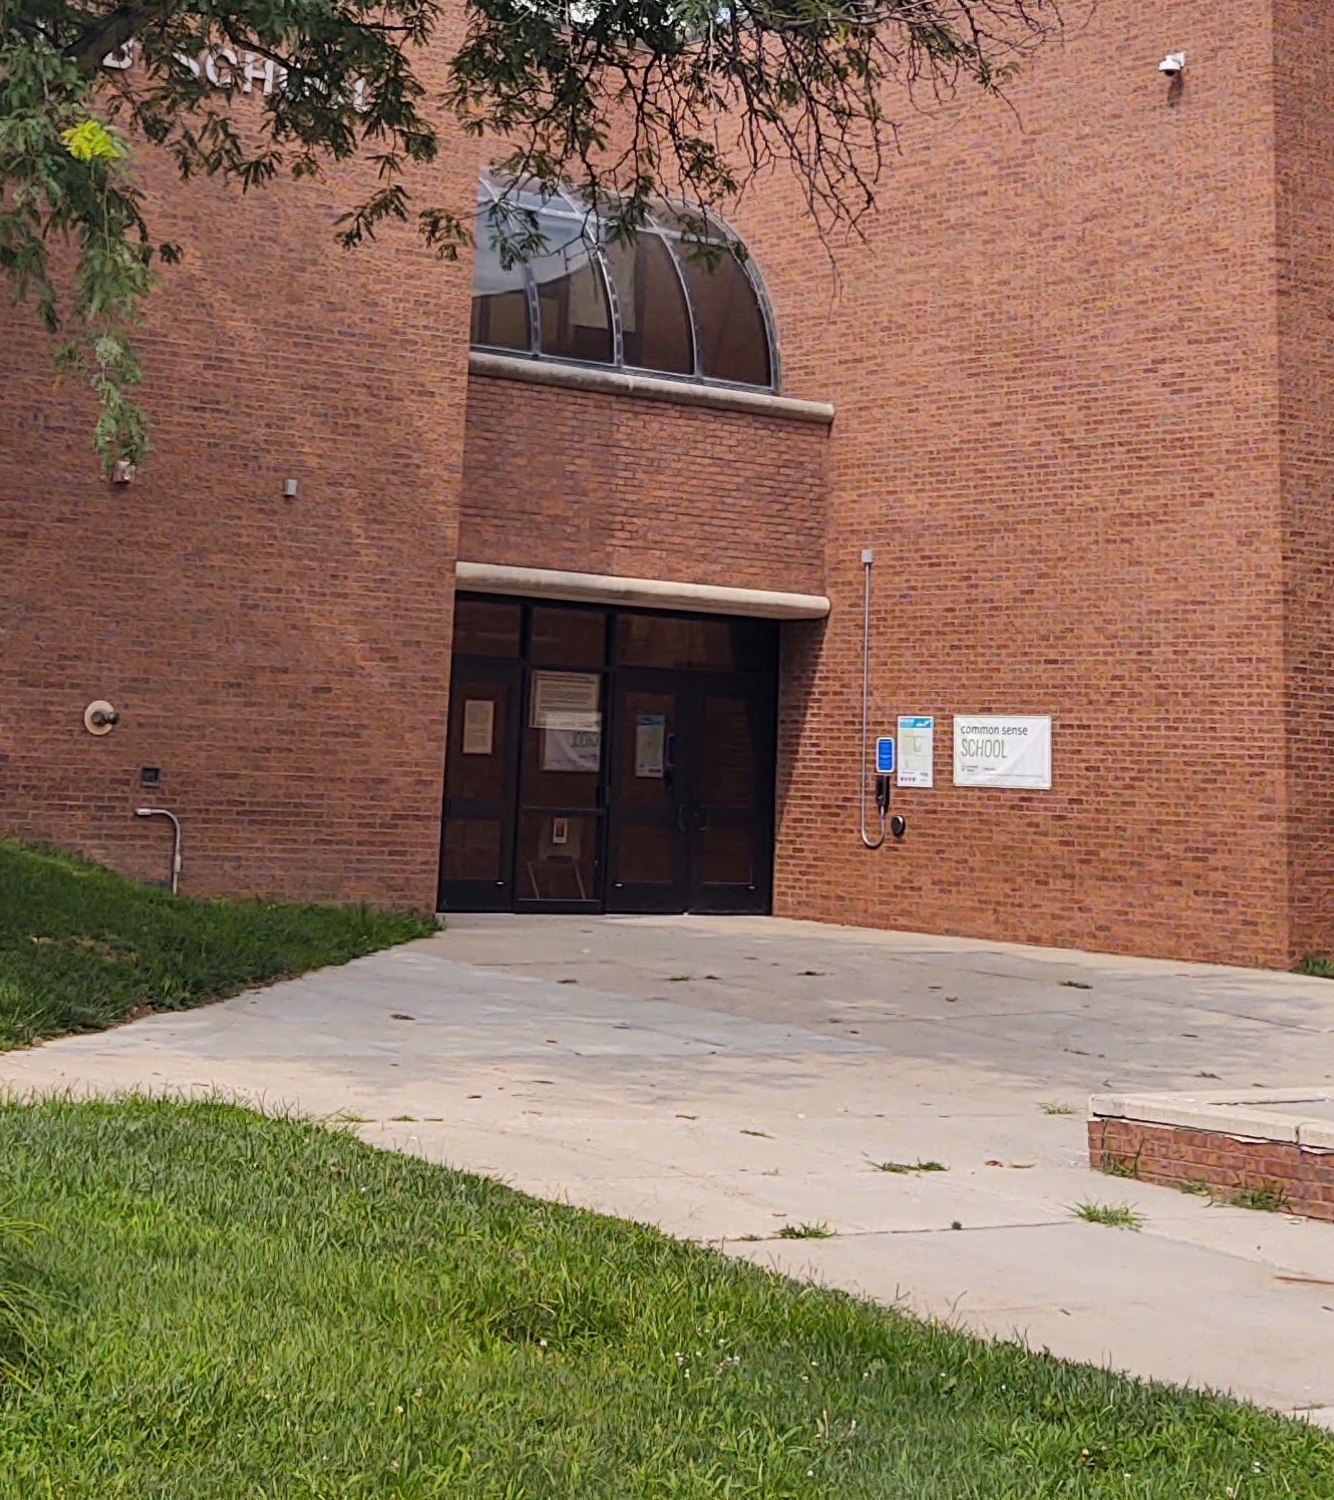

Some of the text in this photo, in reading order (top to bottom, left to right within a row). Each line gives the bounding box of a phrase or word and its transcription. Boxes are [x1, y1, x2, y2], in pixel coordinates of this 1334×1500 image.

[960, 725, 1028, 736] common sense
[961, 738, 1008, 759] SCHOOL
